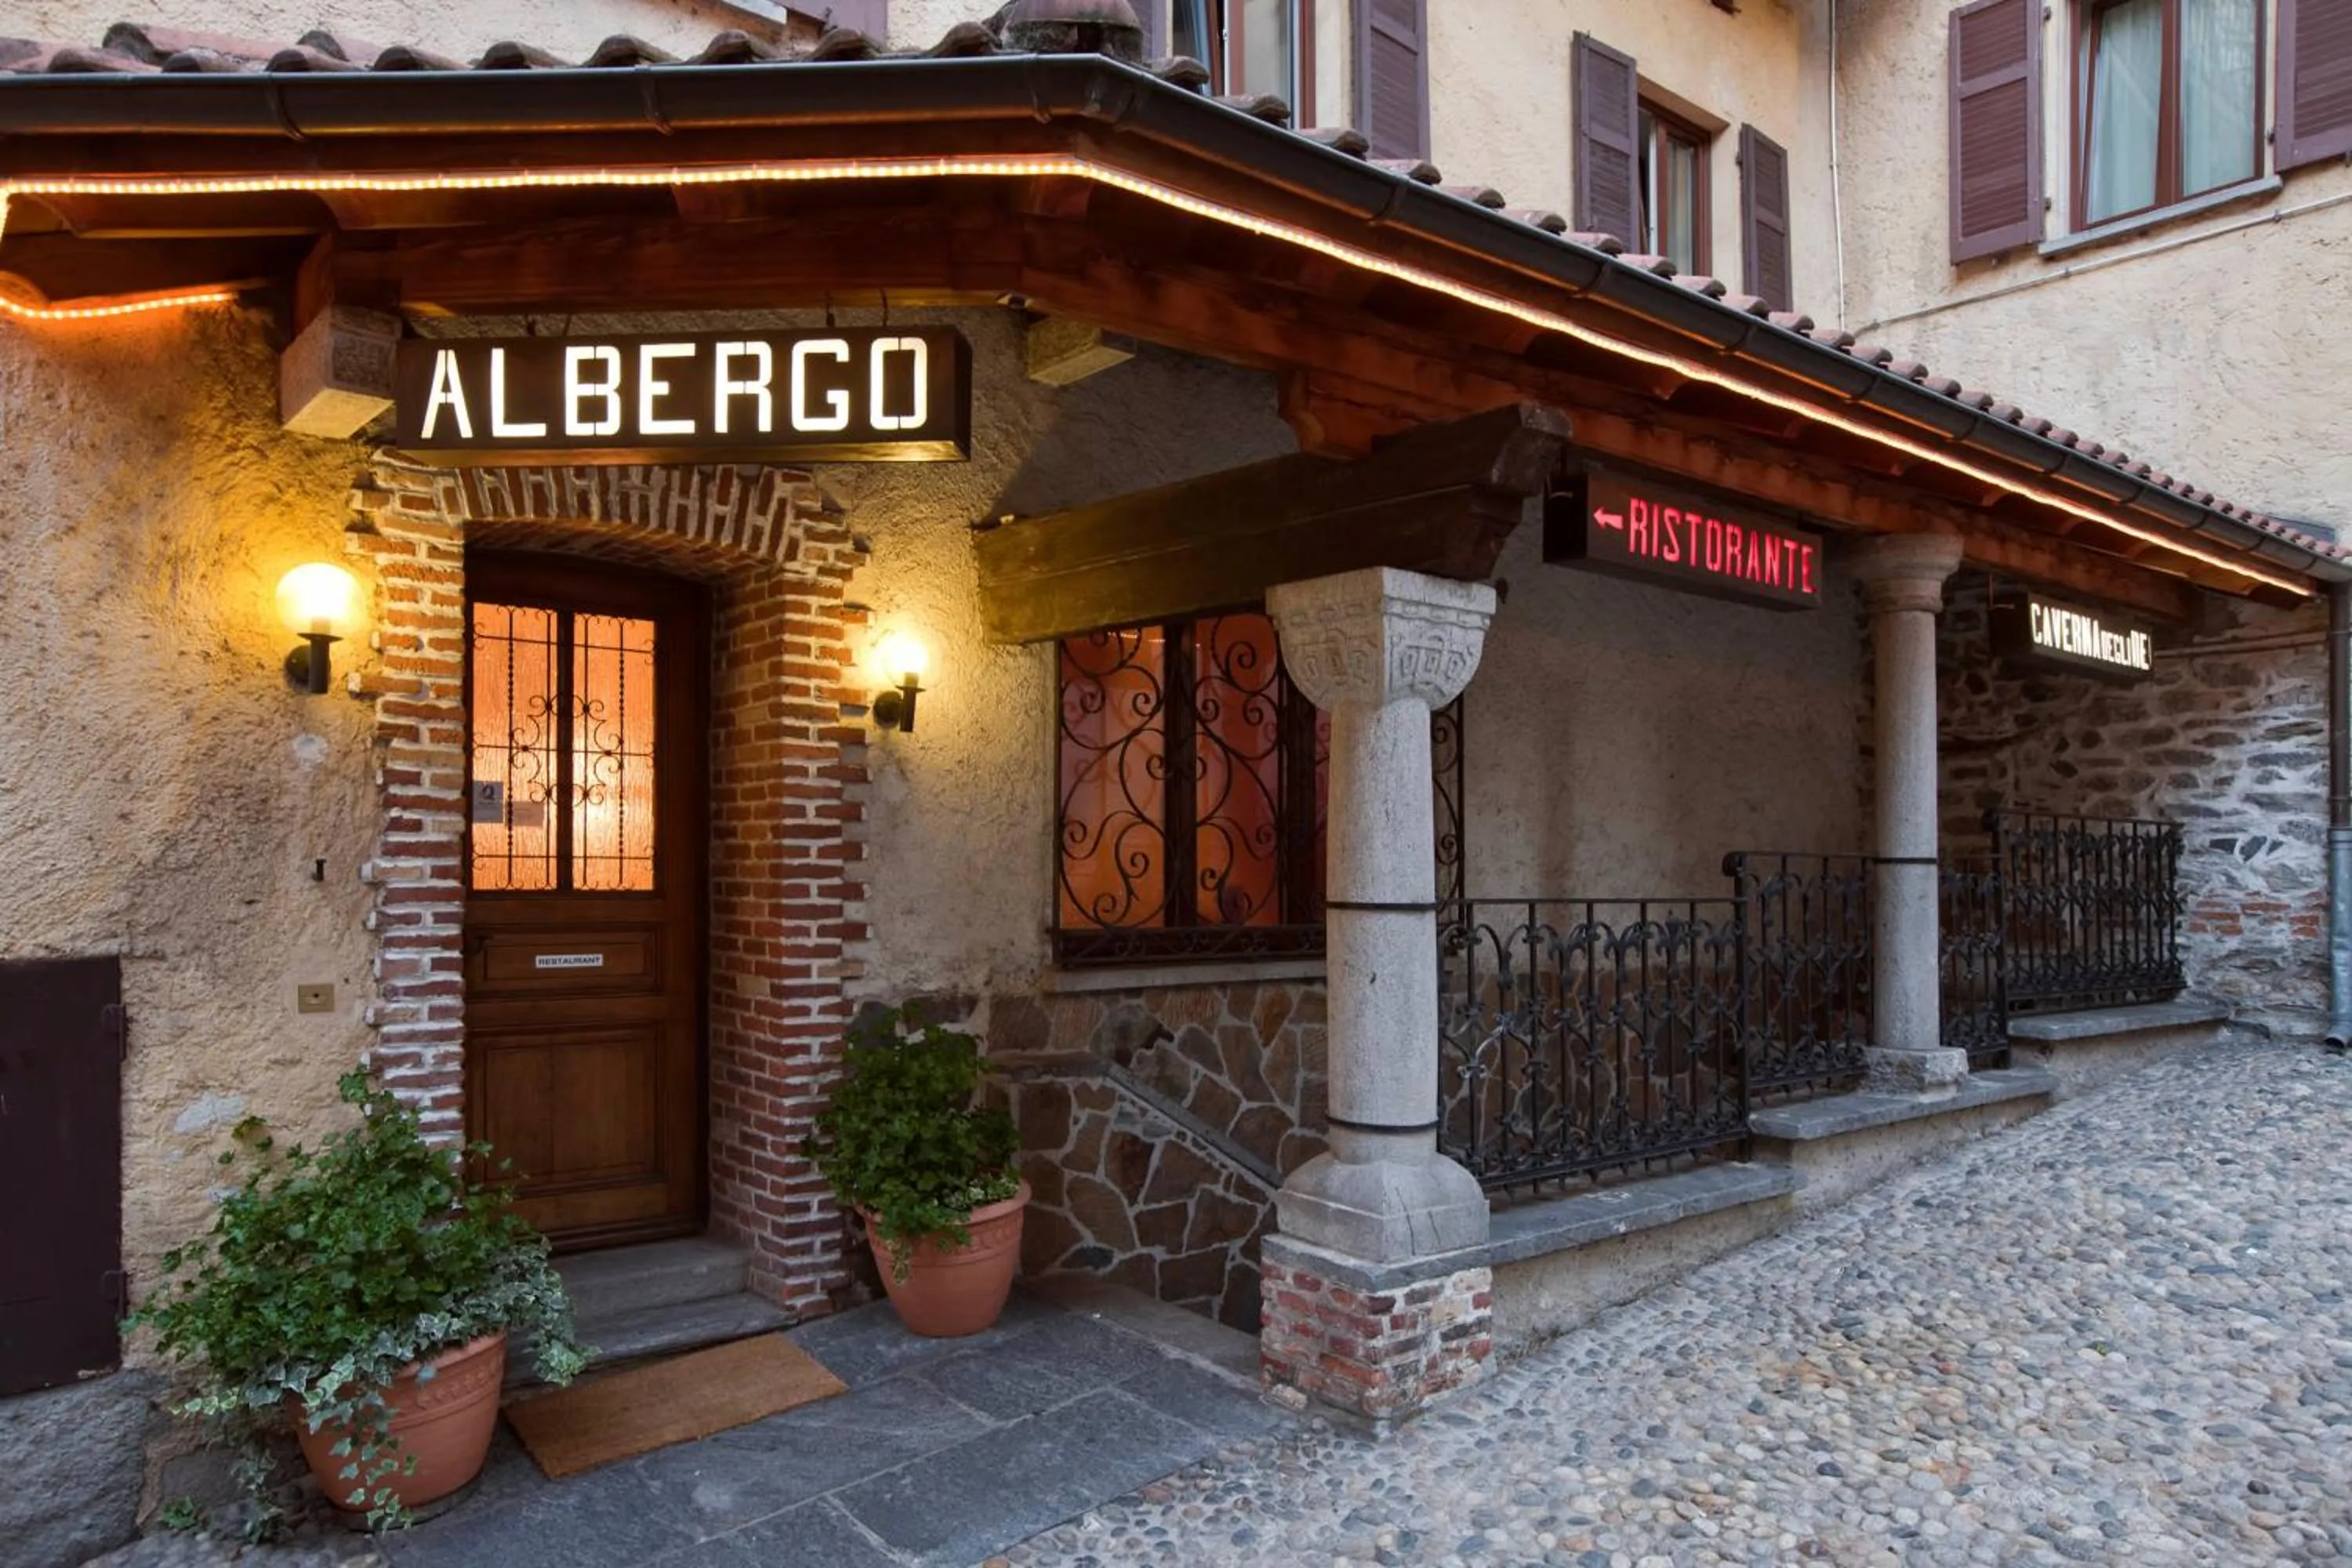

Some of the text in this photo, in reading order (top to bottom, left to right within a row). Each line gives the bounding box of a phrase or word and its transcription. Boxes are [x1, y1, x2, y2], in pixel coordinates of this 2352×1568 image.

[420, 337, 927, 439] ALBERGO
[1629, 498, 1817, 593] RISTORANTE
[2031, 602, 2102, 659] CAVERNA
